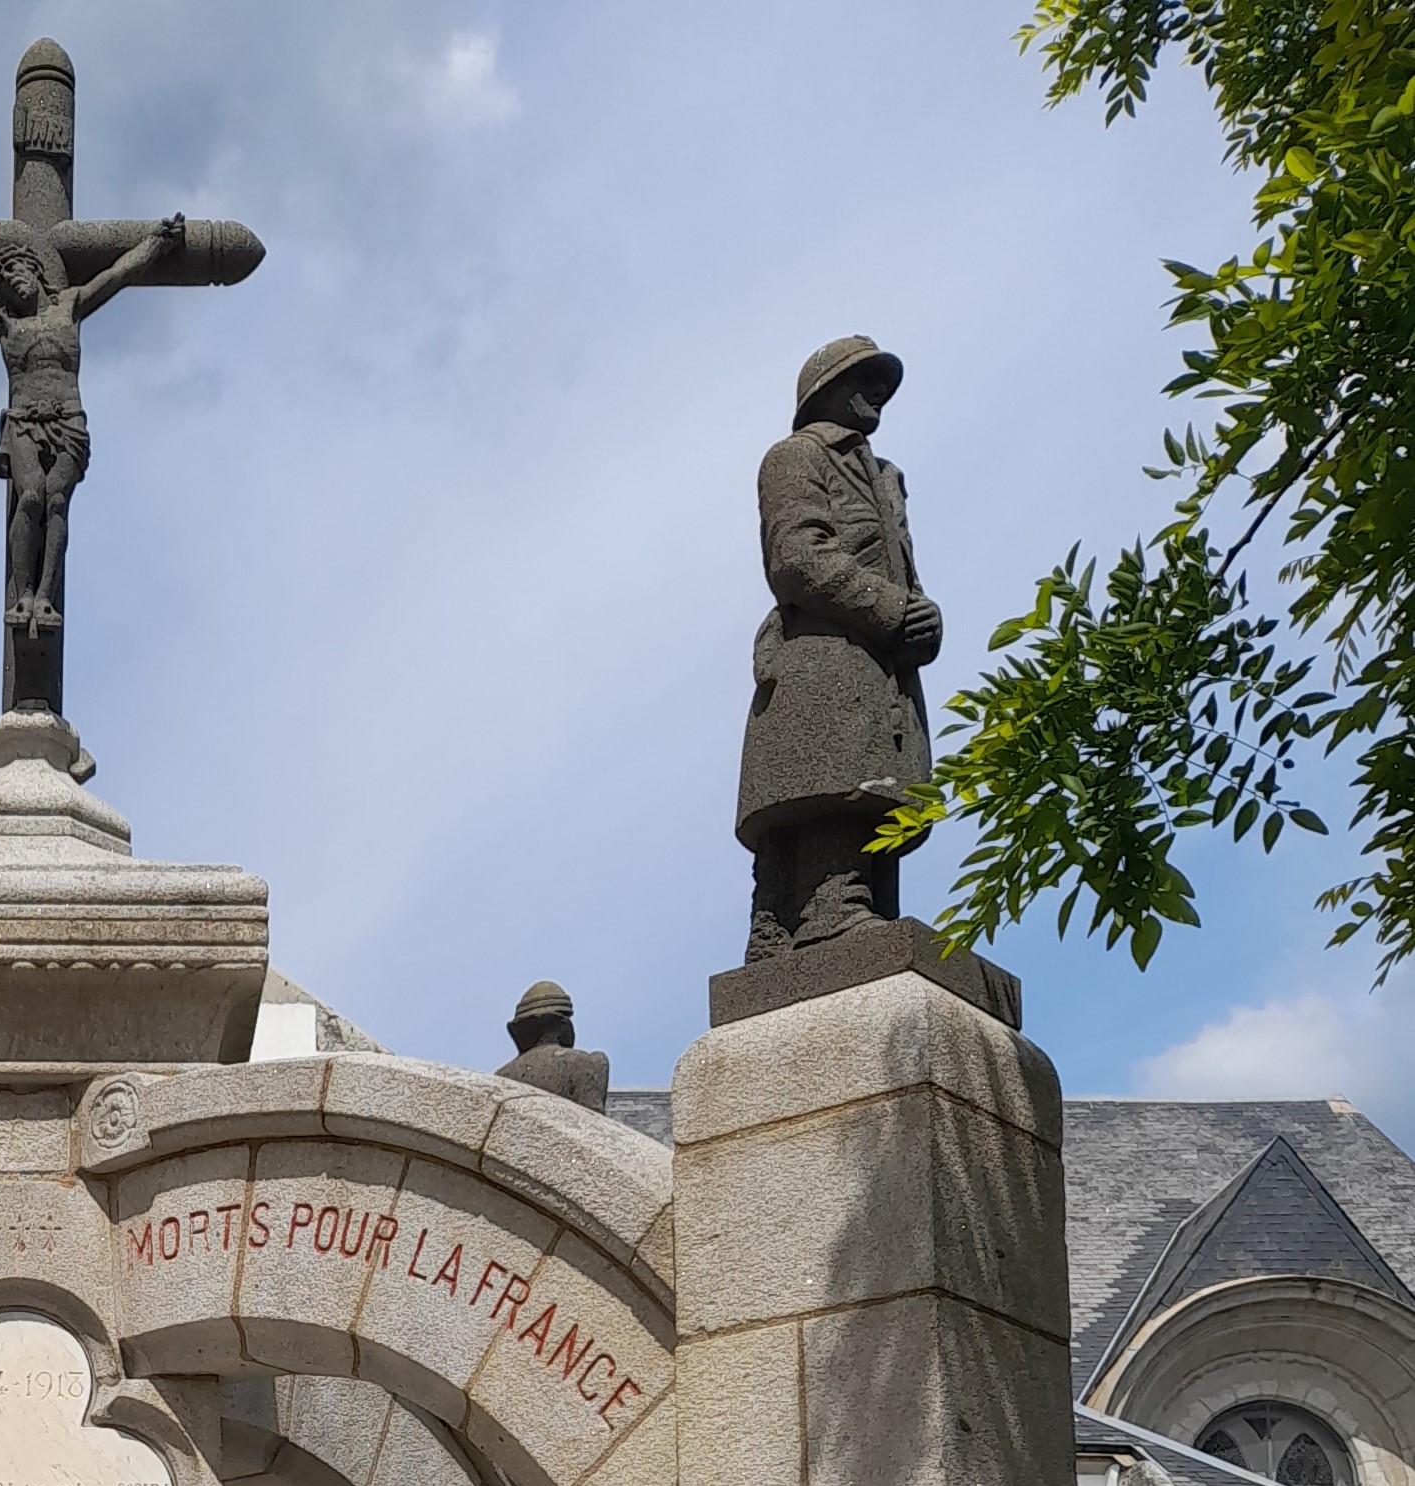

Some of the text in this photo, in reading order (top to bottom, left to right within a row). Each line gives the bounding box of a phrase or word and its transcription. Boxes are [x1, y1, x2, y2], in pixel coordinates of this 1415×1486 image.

[126, 1202, 642, 1430] MORTS POUR LA FRANCE
